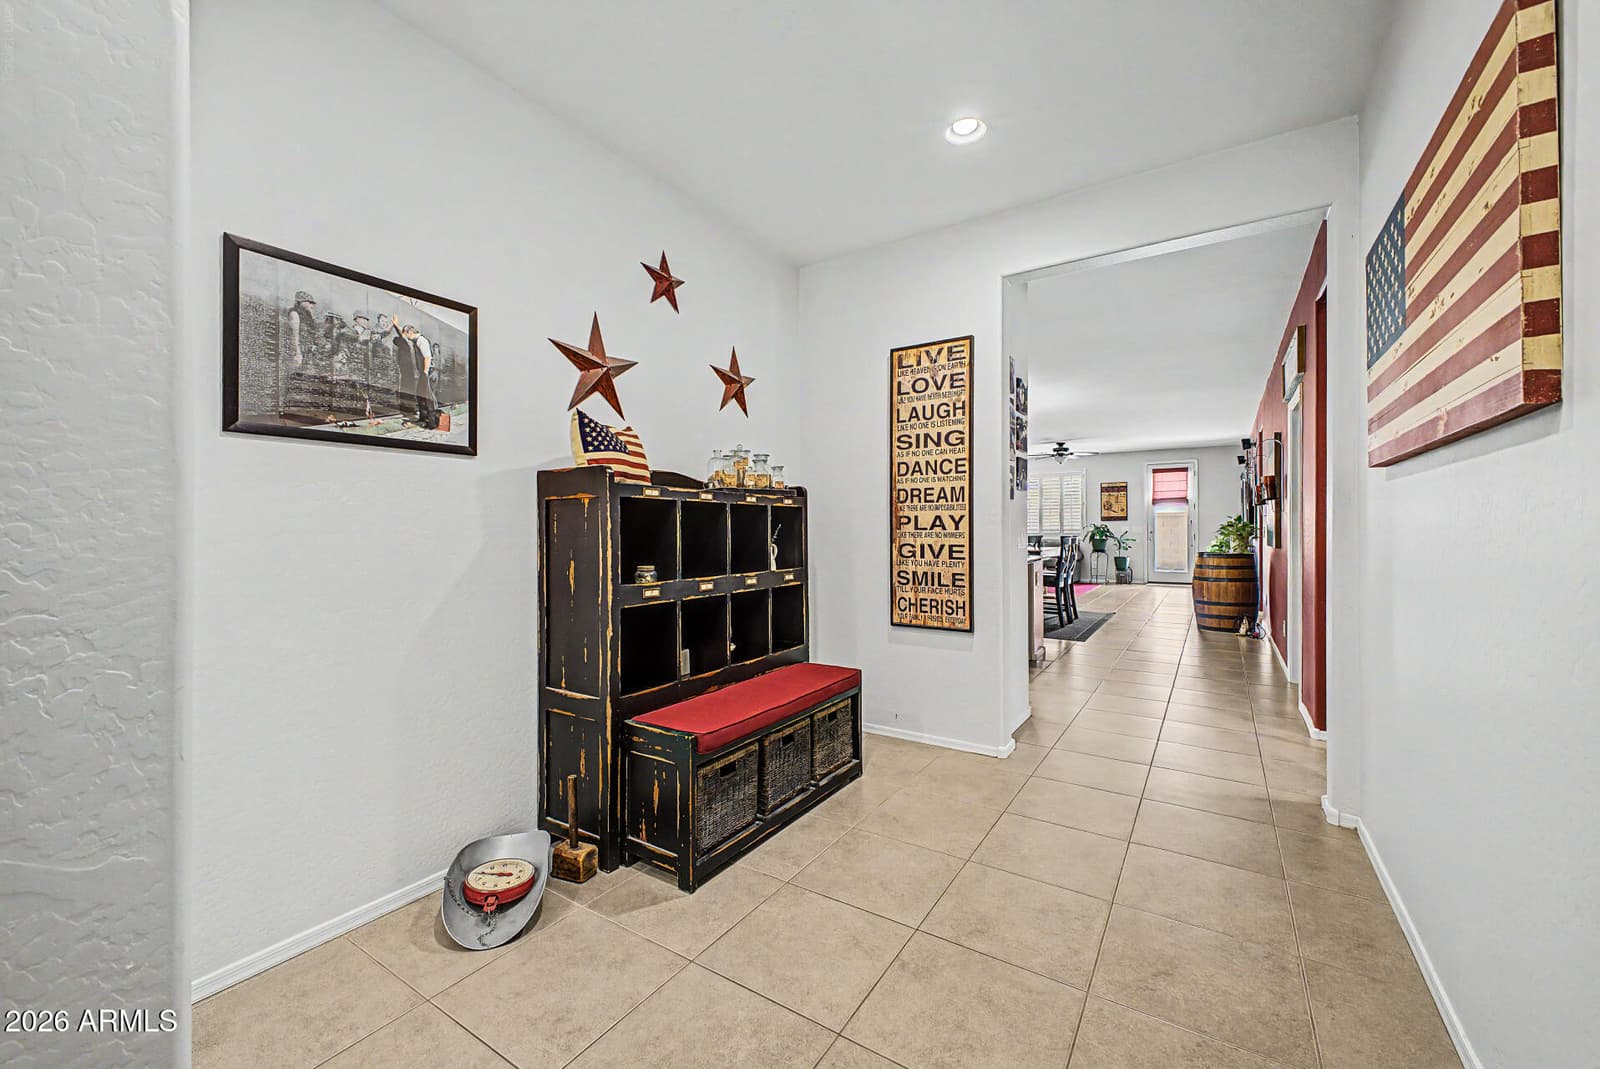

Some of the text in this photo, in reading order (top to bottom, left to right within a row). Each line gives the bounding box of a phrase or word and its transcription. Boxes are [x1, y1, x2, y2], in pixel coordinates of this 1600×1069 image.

[898, 344, 966, 369] LIVE
[897, 372, 965, 396] LOVE
[896, 400, 965, 424] LAUGH
[898, 424, 908, 432] LIKE
[918, 422, 930, 430] ONE
[936, 418, 965, 427] LISTENING
[896, 430, 965, 450] SING
[922, 448, 934, 456] ONE
[934, 448, 948, 456] CAN
[948, 446, 966, 454] HEAR
[897, 458, 967, 477] DANCE
[937, 474, 966, 482] WATCHING
[897, 486, 965, 504] DREAM
[897, 514, 966, 530] PLAY
[898, 542, 966, 560] GIVE
[896, 570, 966, 588] SMILE
[927, 586, 944, 594] FACE
[944, 588, 966, 597] HURTS
[898, 596, 966, 616] CHERISH
